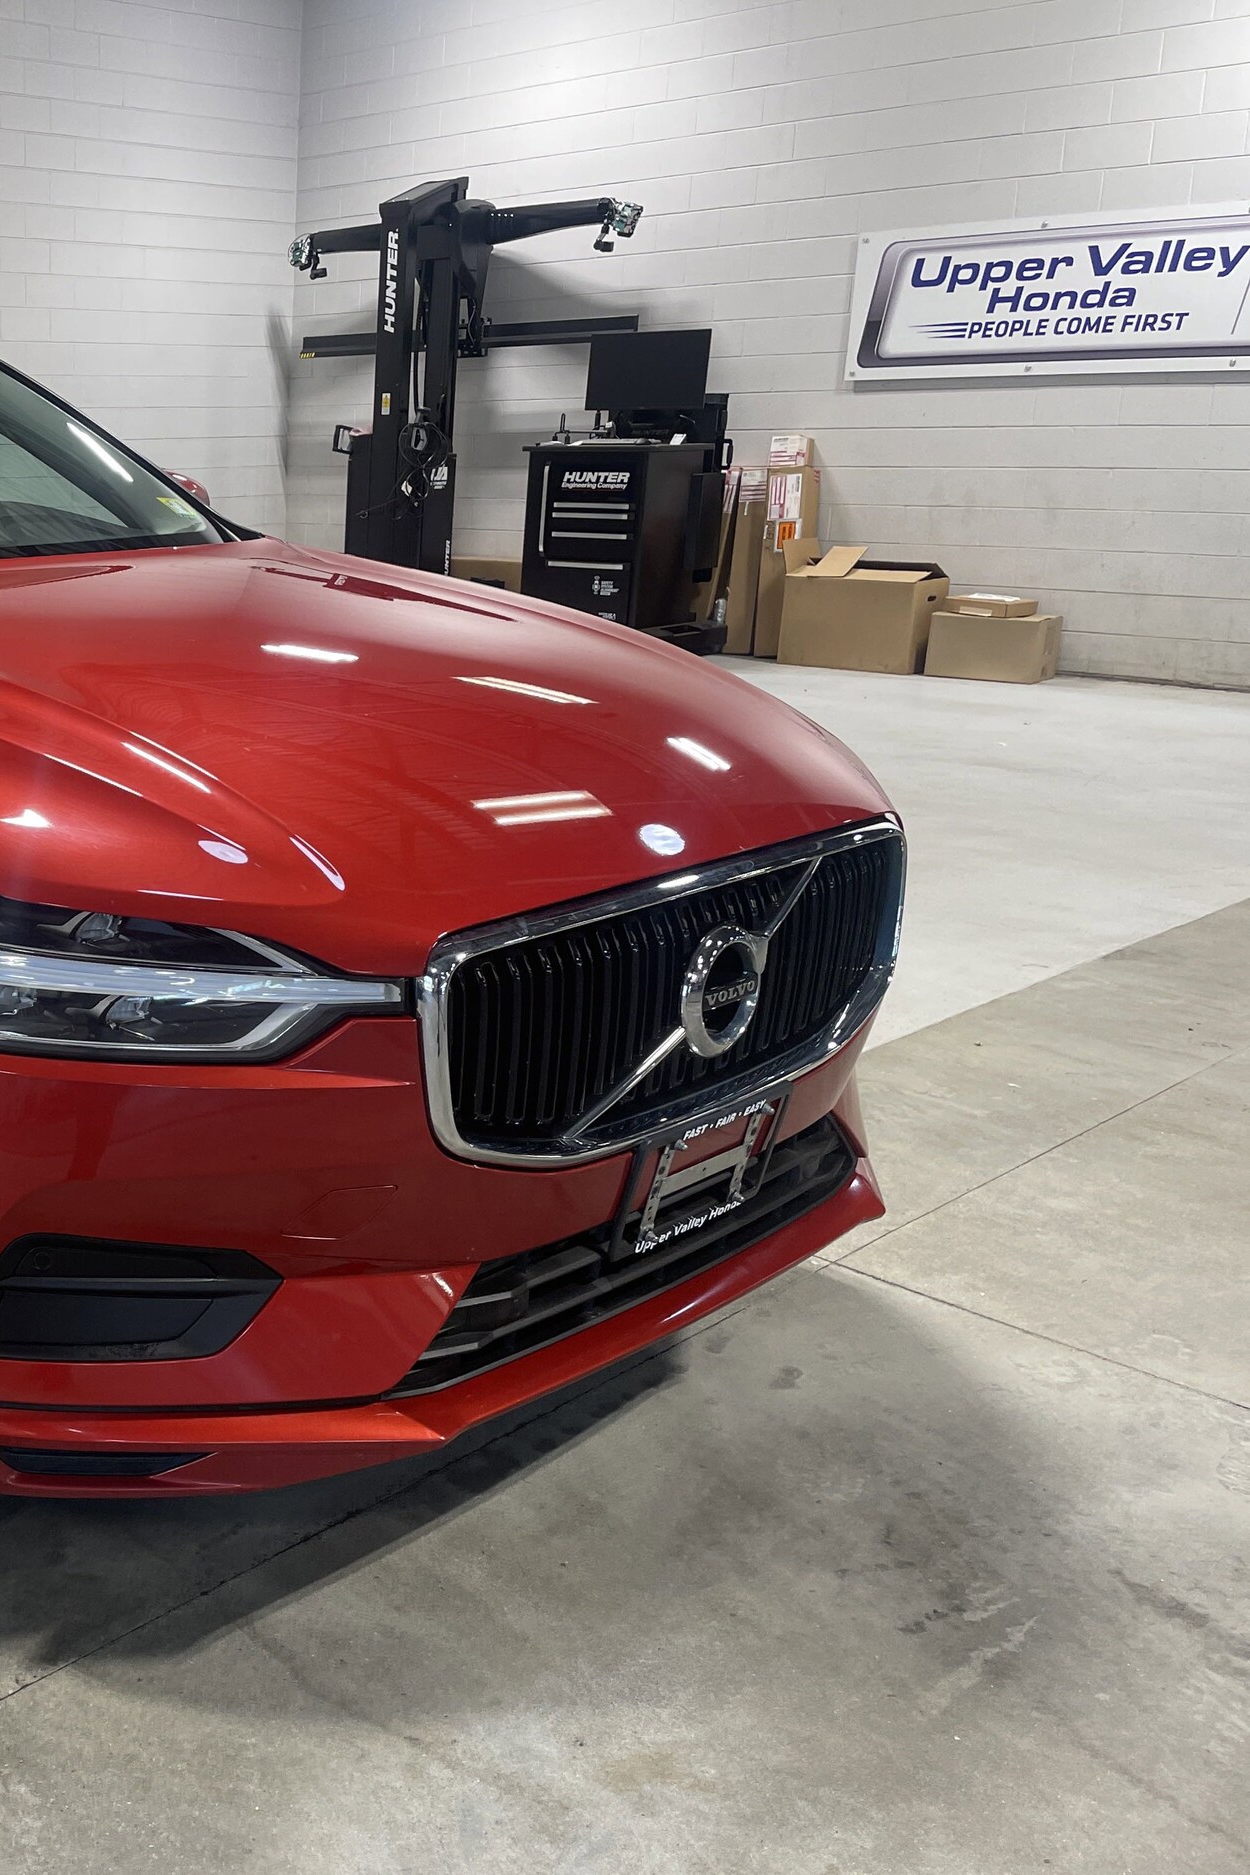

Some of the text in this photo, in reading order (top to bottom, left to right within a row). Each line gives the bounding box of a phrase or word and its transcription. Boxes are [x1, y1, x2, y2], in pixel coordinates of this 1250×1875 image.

[911, 239, 1250, 293] Upper Valley
[384, 230, 399, 333] HUNTER
[986, 280, 1136, 314] Honda
[967, 312, 1190, 339] PEOPLE COME FIRST
[561, 482, 628, 491] Engineering Company
[563, 471, 630, 483] HUNTER
[705, 980, 755, 1006] VOLVO
[683, 1099, 767, 1140] FAST FAIR EASY
[674, 1214, 707, 1236] Valley
